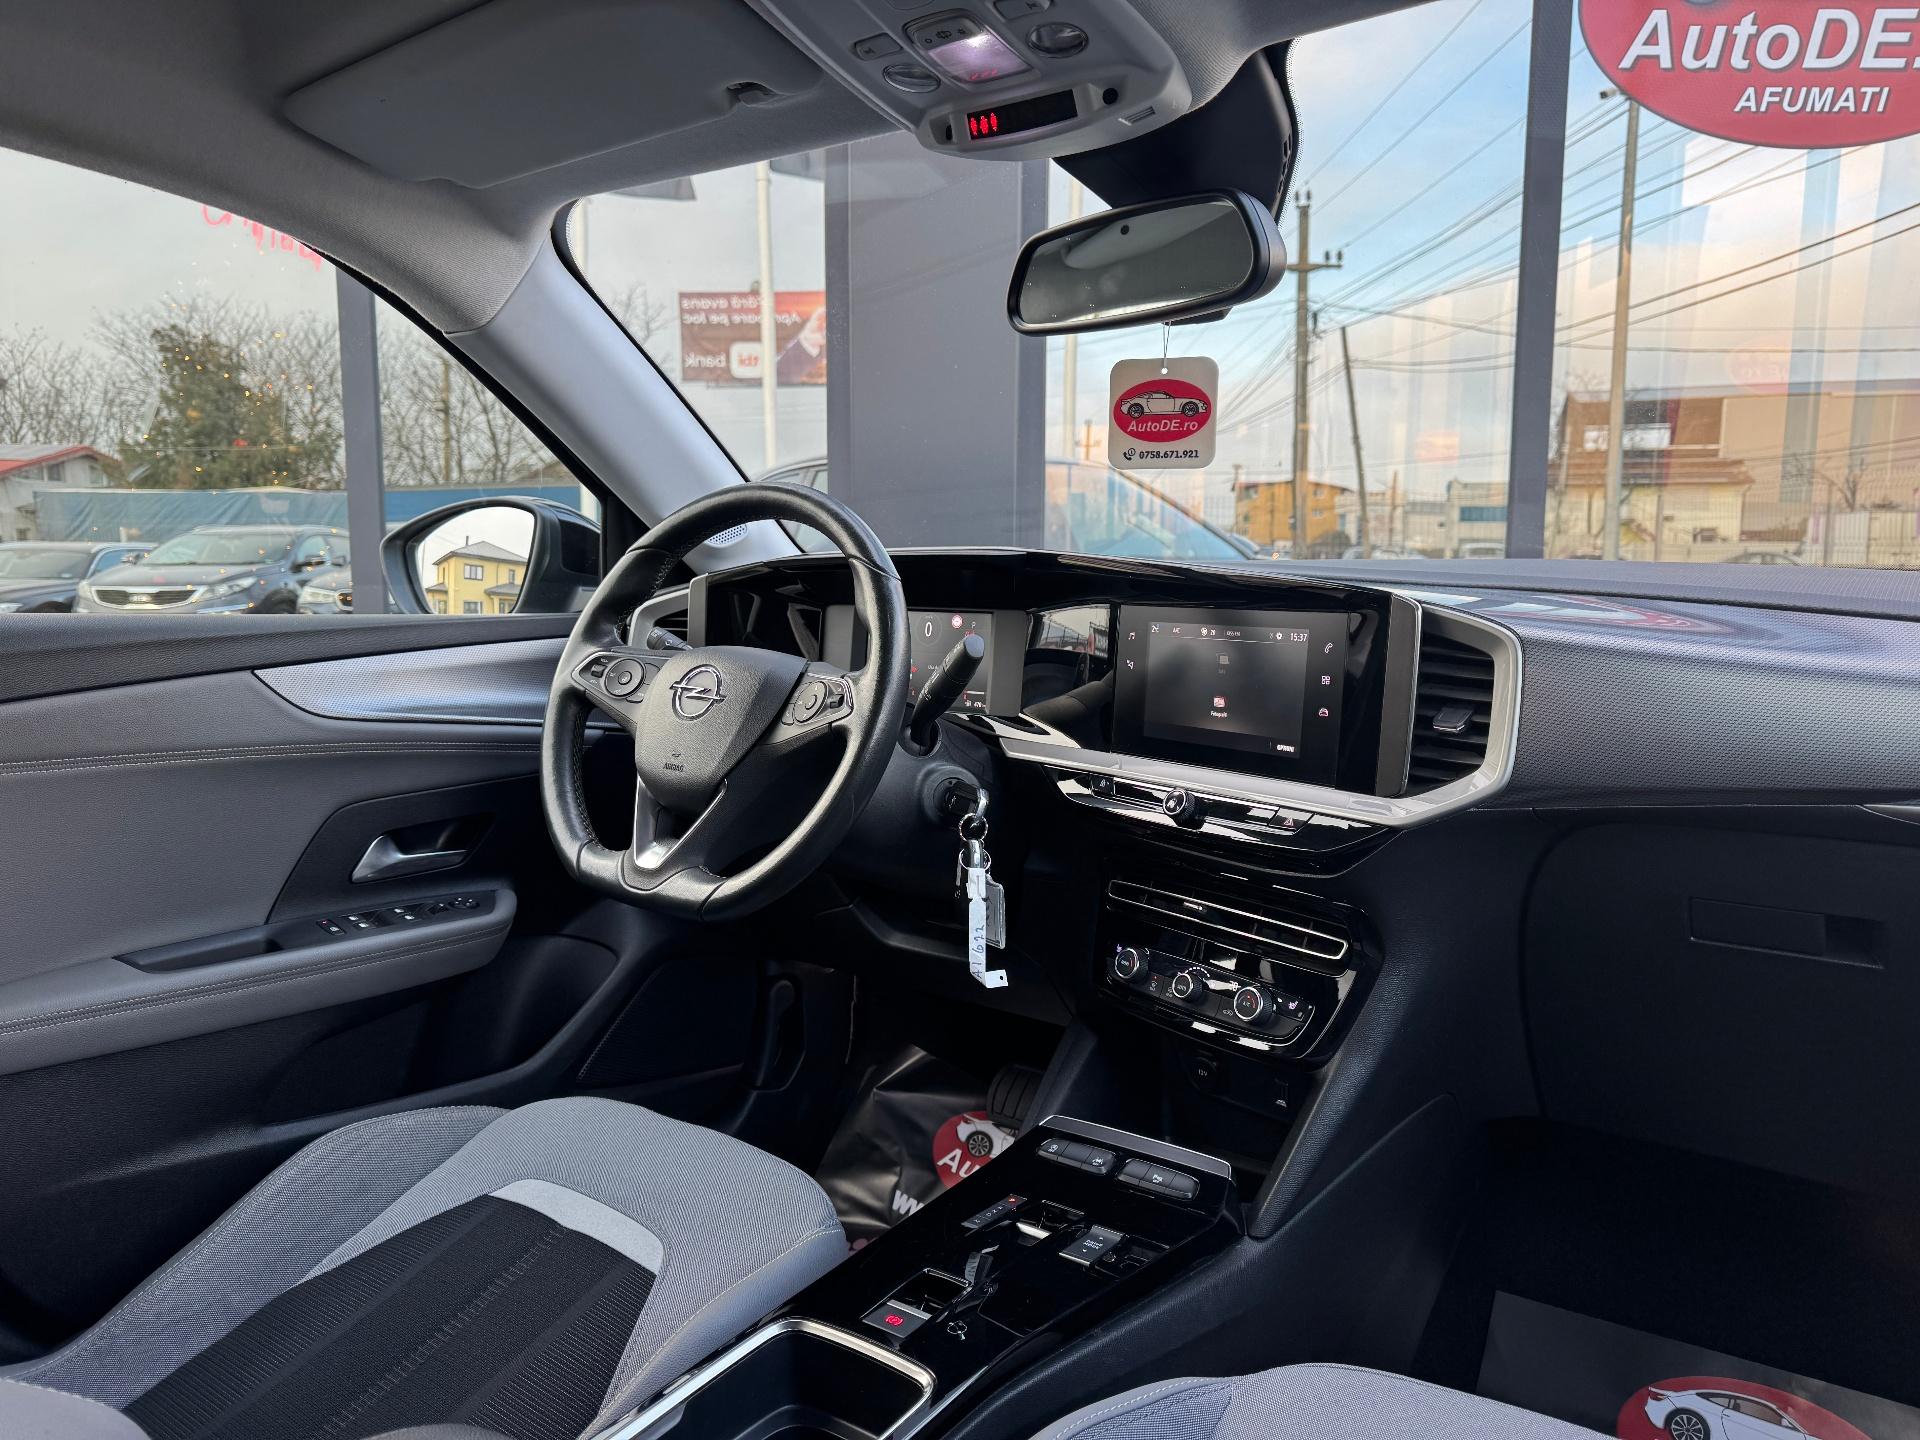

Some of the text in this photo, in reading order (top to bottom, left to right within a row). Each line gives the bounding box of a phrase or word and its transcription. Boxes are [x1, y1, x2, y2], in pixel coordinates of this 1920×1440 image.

[1733, 86, 1890, 113] AFUMATI
[1127, 419, 1199, 432] AutoDE.ro
[1139, 449, 1200, 460] 0758.671.921
[1290, 632, 1308, 642] 15:37
